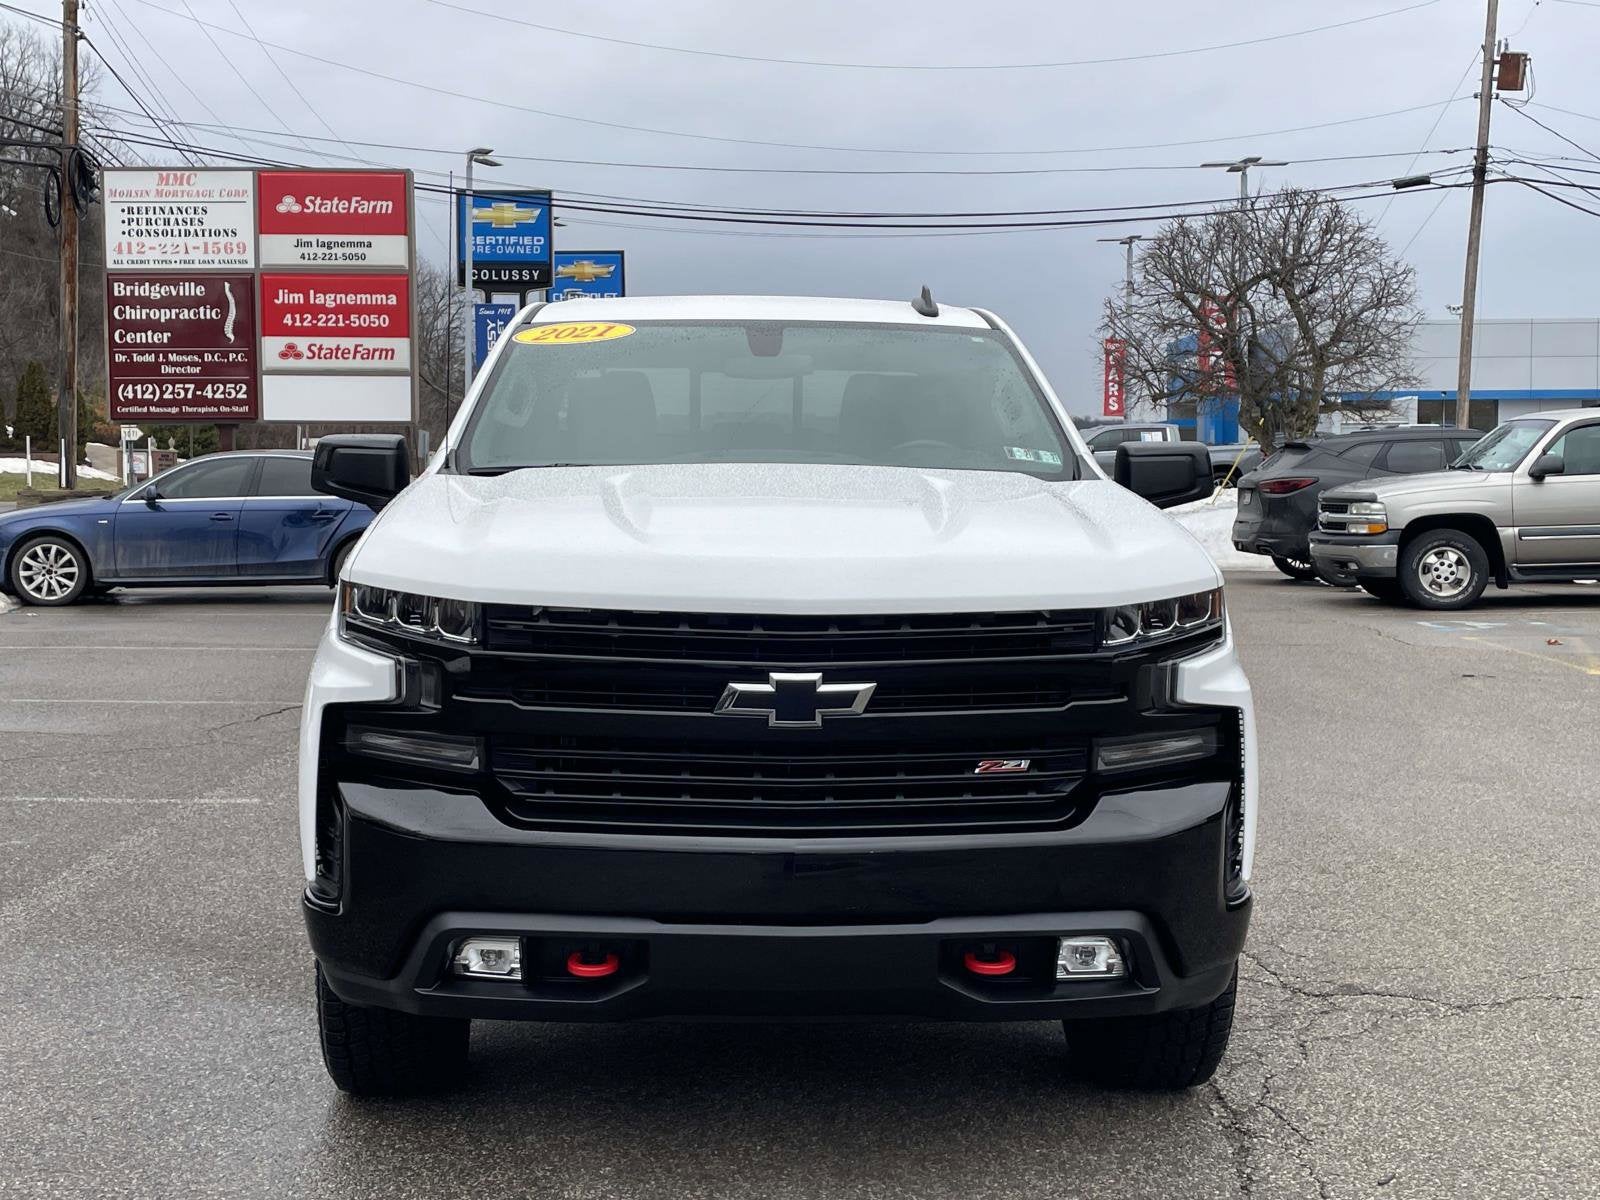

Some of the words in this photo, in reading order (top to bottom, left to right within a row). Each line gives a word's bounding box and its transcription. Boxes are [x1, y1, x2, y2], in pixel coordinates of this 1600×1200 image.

[156, 172, 197, 187] MMC
[154, 188, 215, 199] MORTGAGE
[219, 188, 249, 199] CORP.
[127, 205, 208, 216] REFINANCES
[127, 217, 205, 227] PURCHASES
[127, 228, 238, 238] CONSOLIDATIONS
[113, 240, 247, 255] 412-221-1569
[294, 238, 313, 248] Jim
[316, 238, 373, 250] Iagnemma
[299, 252, 367, 261] 412-221-5050
[471, 269, 540, 280] COLUSSY
[113, 281, 206, 300] Bridgeville
[274, 289, 304, 305] Jim
[309, 289, 397, 308] Iagnemma
[113, 305, 222, 323] Chiropractic
[282, 313, 390, 328] 412-221-5050
[113, 328, 172, 344] Center
[531, 325, 617, 342] 2021
[114, 353, 130, 363] Dr.
[132, 353, 155, 363] Todd
[157, 353, 166, 363] J.
[168, 353, 202, 364] Moses,
[160, 365, 202, 374] Director
[117, 383, 160, 402] (412)
[162, 383, 248, 400] 257-4252
[116, 405, 148, 413] Certified
[149, 405, 180, 414] Massage
[182, 405, 218, 414] Therapists
[219, 405, 249, 413] On-Staff
